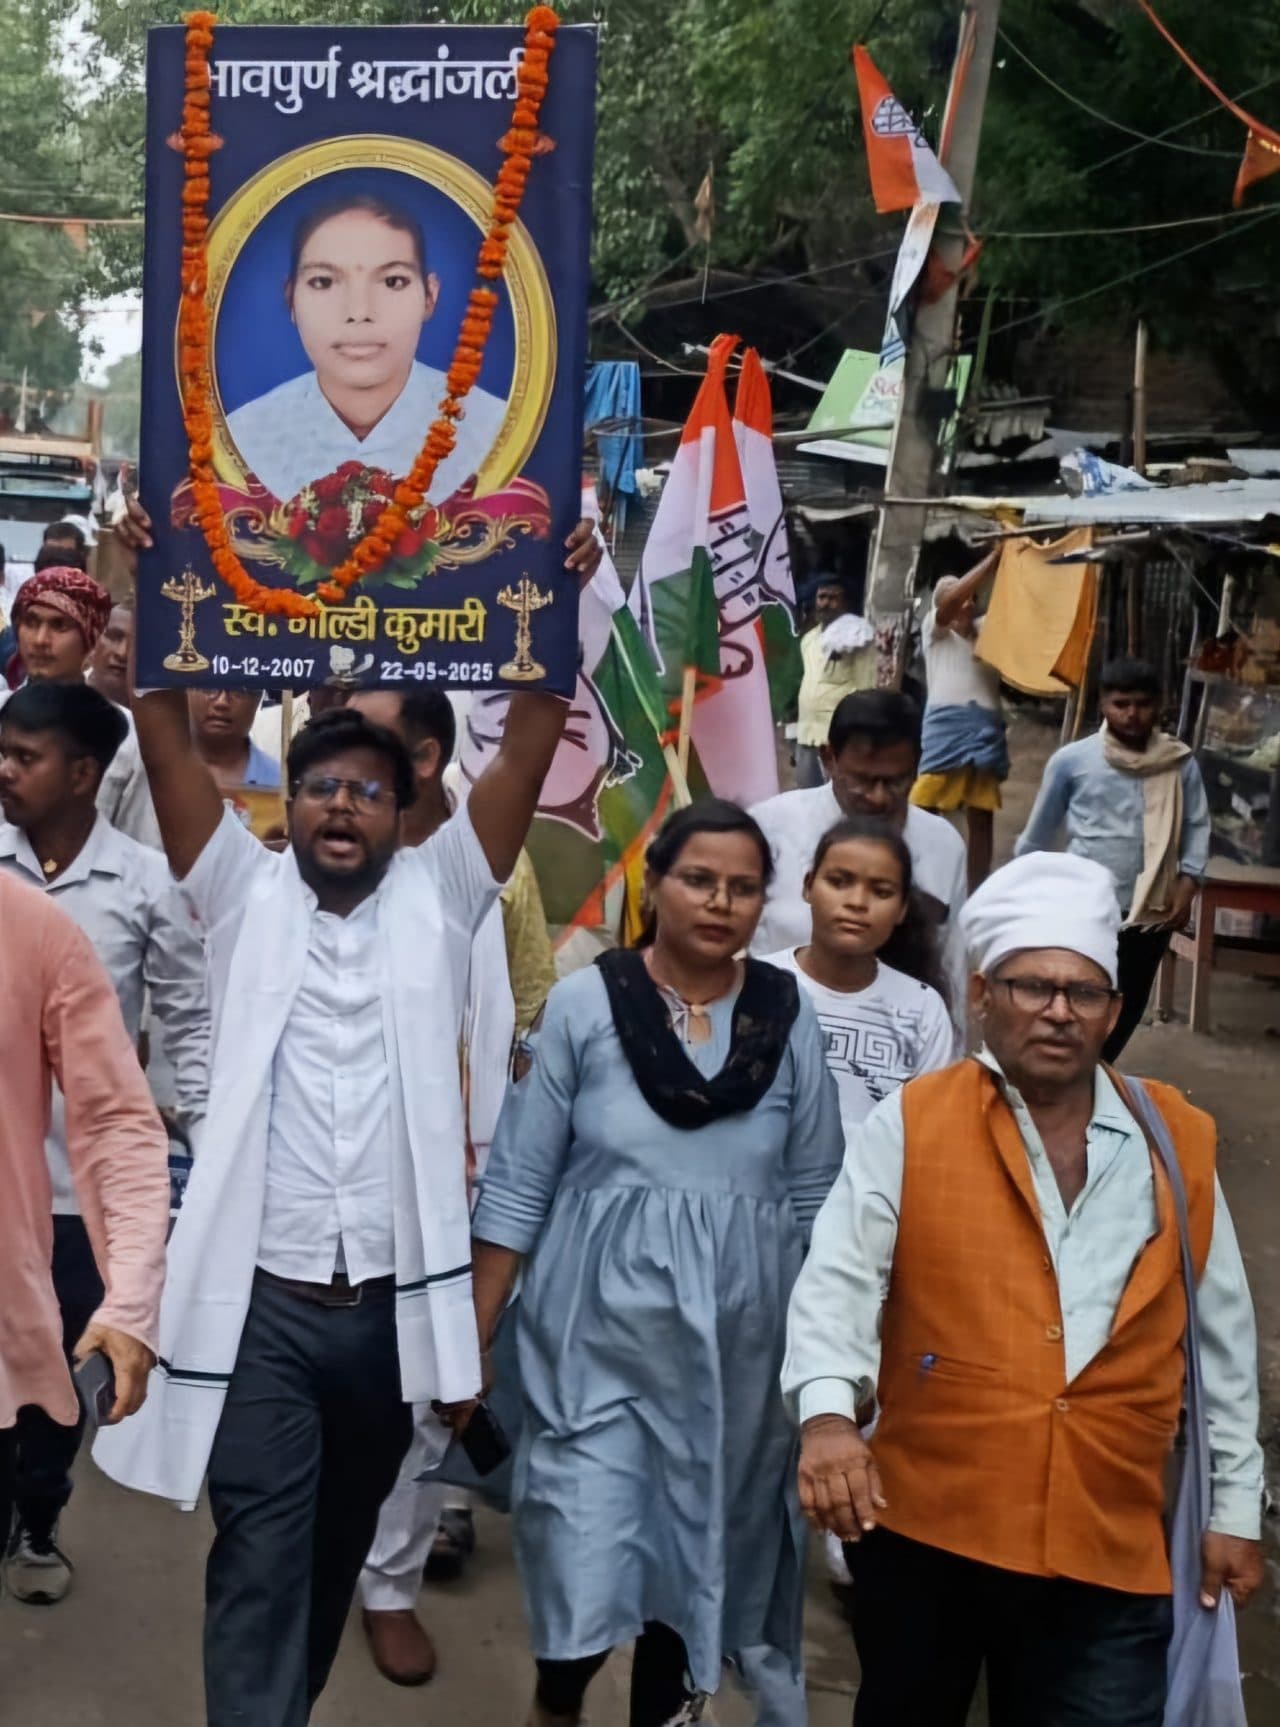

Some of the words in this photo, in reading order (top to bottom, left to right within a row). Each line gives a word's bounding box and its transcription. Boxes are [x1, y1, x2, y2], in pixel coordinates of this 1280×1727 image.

[383, 598, 487, 654] कुमारी
[211, 655, 315, 678] 10-12-2007
[380, 661, 493, 681] 22-05-2025
